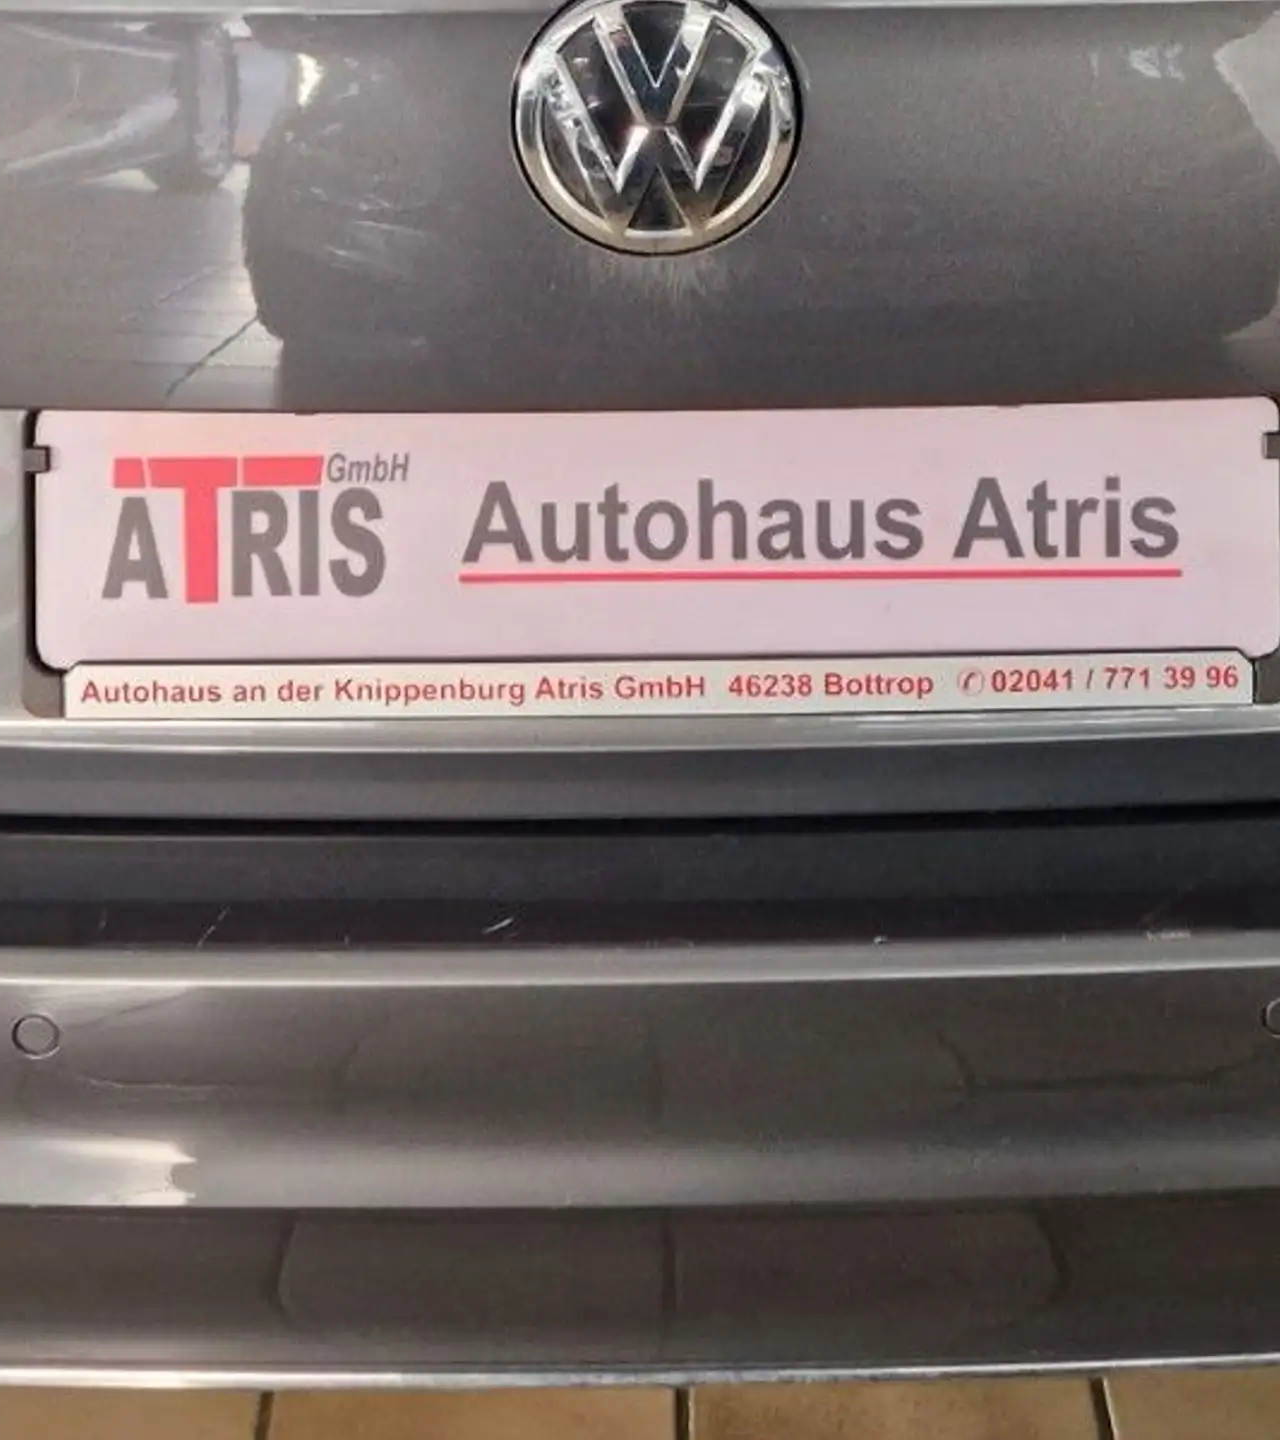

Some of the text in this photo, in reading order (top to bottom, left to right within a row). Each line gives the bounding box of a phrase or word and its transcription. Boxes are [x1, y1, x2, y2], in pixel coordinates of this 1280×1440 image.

[326, 452, 410, 484] GmbH
[101, 455, 387, 604] ATRIS
[460, 475, 1181, 564] Autohaus Atris
[81, 679, 221, 704] Autohaus
[232, 684, 267, 703] an
[276, 678, 324, 703] der
[334, 675, 527, 707] Knippenburg
[534, 675, 605, 700] Atris
[613, 674, 705, 699] GmbH
[728, 673, 813, 698] 46238
[823, 670, 935, 700] Bottrop
[990, 668, 1074, 694] 02041
[1103, 666, 1151, 691] 771
[1162, 665, 1196, 690] 39
[1205, 664, 1240, 689] 96
